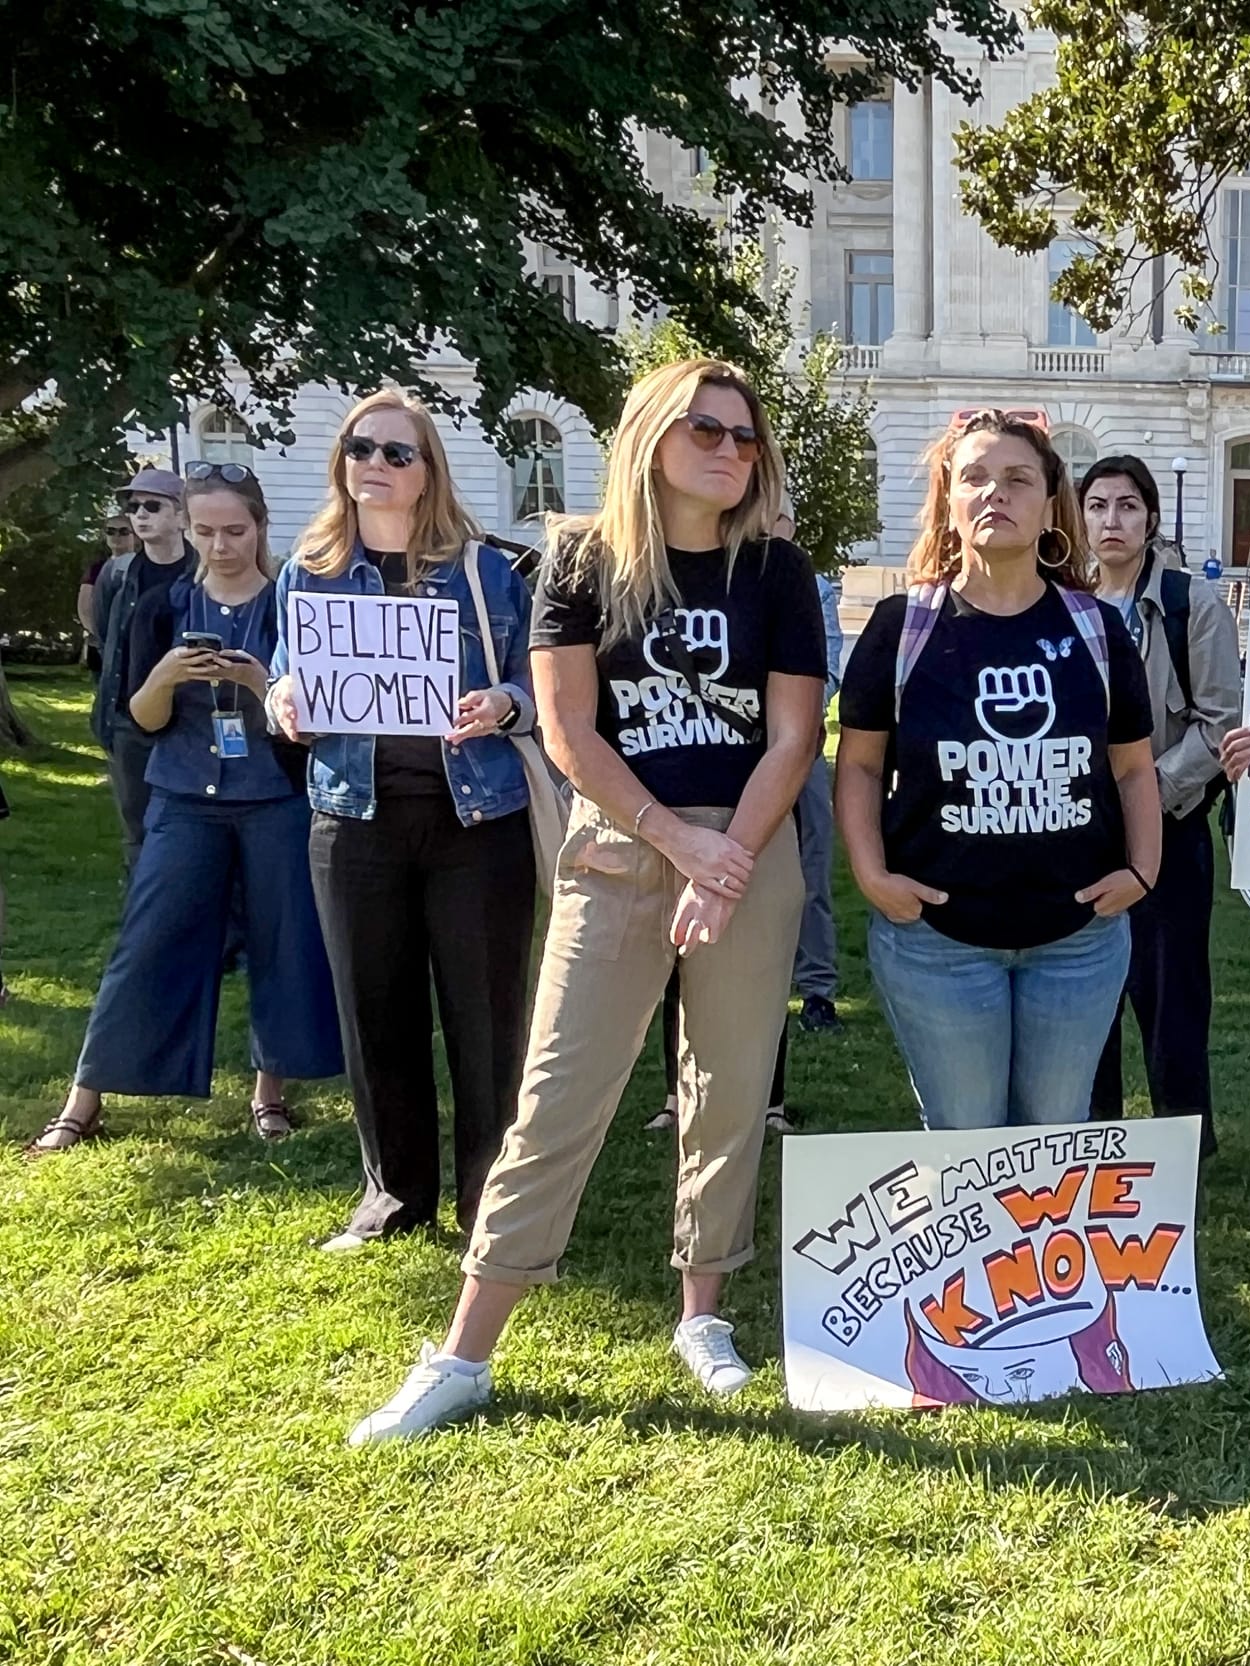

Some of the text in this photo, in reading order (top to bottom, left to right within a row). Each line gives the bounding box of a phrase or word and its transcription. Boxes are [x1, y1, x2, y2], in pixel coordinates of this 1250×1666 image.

[295, 597, 458, 664] BELIEVE
[298, 666, 456, 729] WOMEN
[618, 718, 753, 756] SURVIVO
[937, 735, 1092, 782] POWER
[940, 798, 1092, 834] SURVIVORS
[966, 776, 1072, 808] TO THE
[792, 1126, 1127, 1275] WE MATTER
[822, 1161, 1156, 1347] BECAUSE WE
